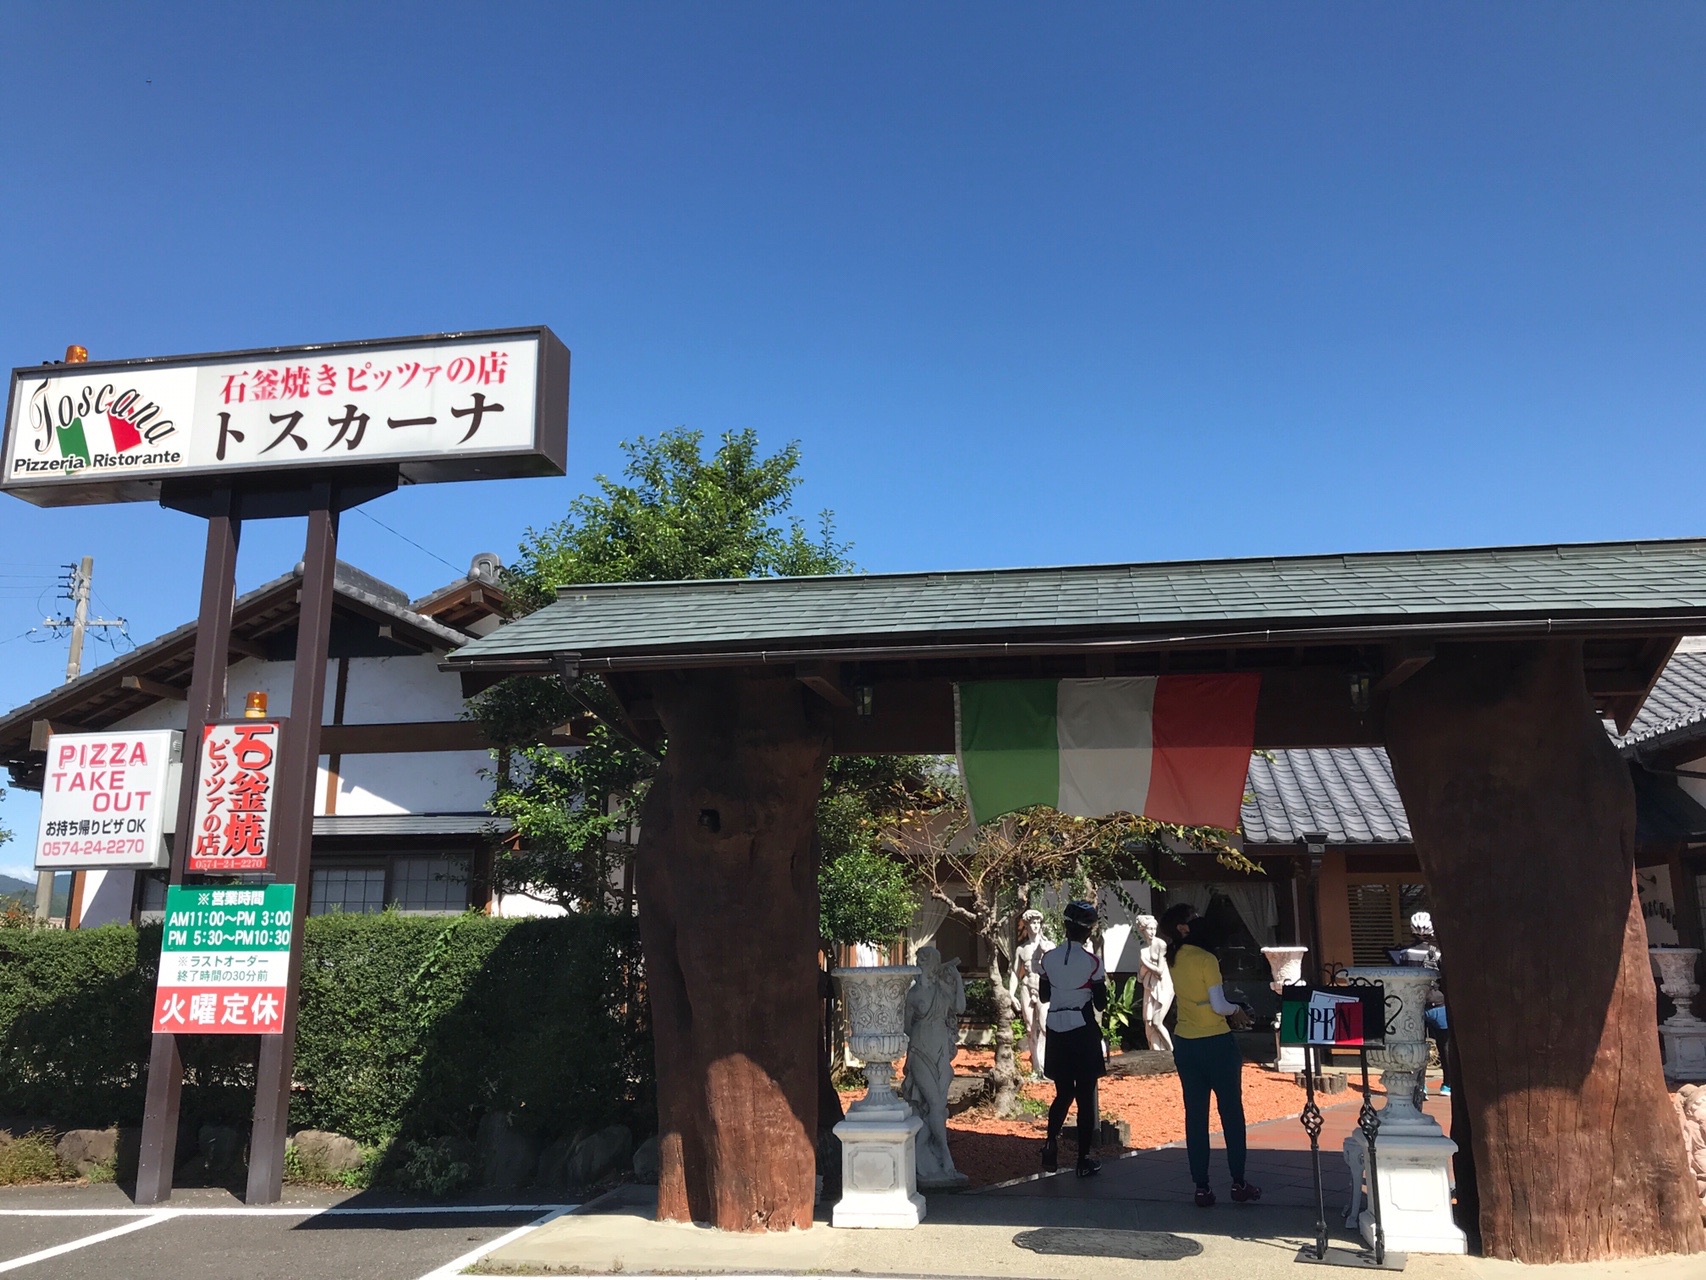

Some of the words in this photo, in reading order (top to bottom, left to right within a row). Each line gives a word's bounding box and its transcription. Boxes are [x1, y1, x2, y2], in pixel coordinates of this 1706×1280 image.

[218, 350, 508, 404] 石釜焼きピッツァの店
[29, 378, 177, 453] Toscana
[214, 391, 505, 461] トスカーナ
[14, 456, 85, 472] Pizzeria
[93, 449, 181, 468] Ristorante
[58, 741, 147, 770] PIZZA
[52, 770, 126, 793] TAKE
[221, 725, 274, 857] 石釜焼
[92, 791, 151, 813] OUT
[45, 819, 124, 837] お持ち帰りピザ
[126, 818, 146, 834] OK
[42, 838, 145, 857] 0574-24-2270
[261, 910, 291, 926] 3:00
[1643, 900, 1677, 930] oscana
[167, 930, 187, 946] PM
[177, 970, 268, 982] 終了時間の30分前
[159, 993, 279, 1025] 火曜定休
[1294, 1006, 1352, 1041] OPEN
